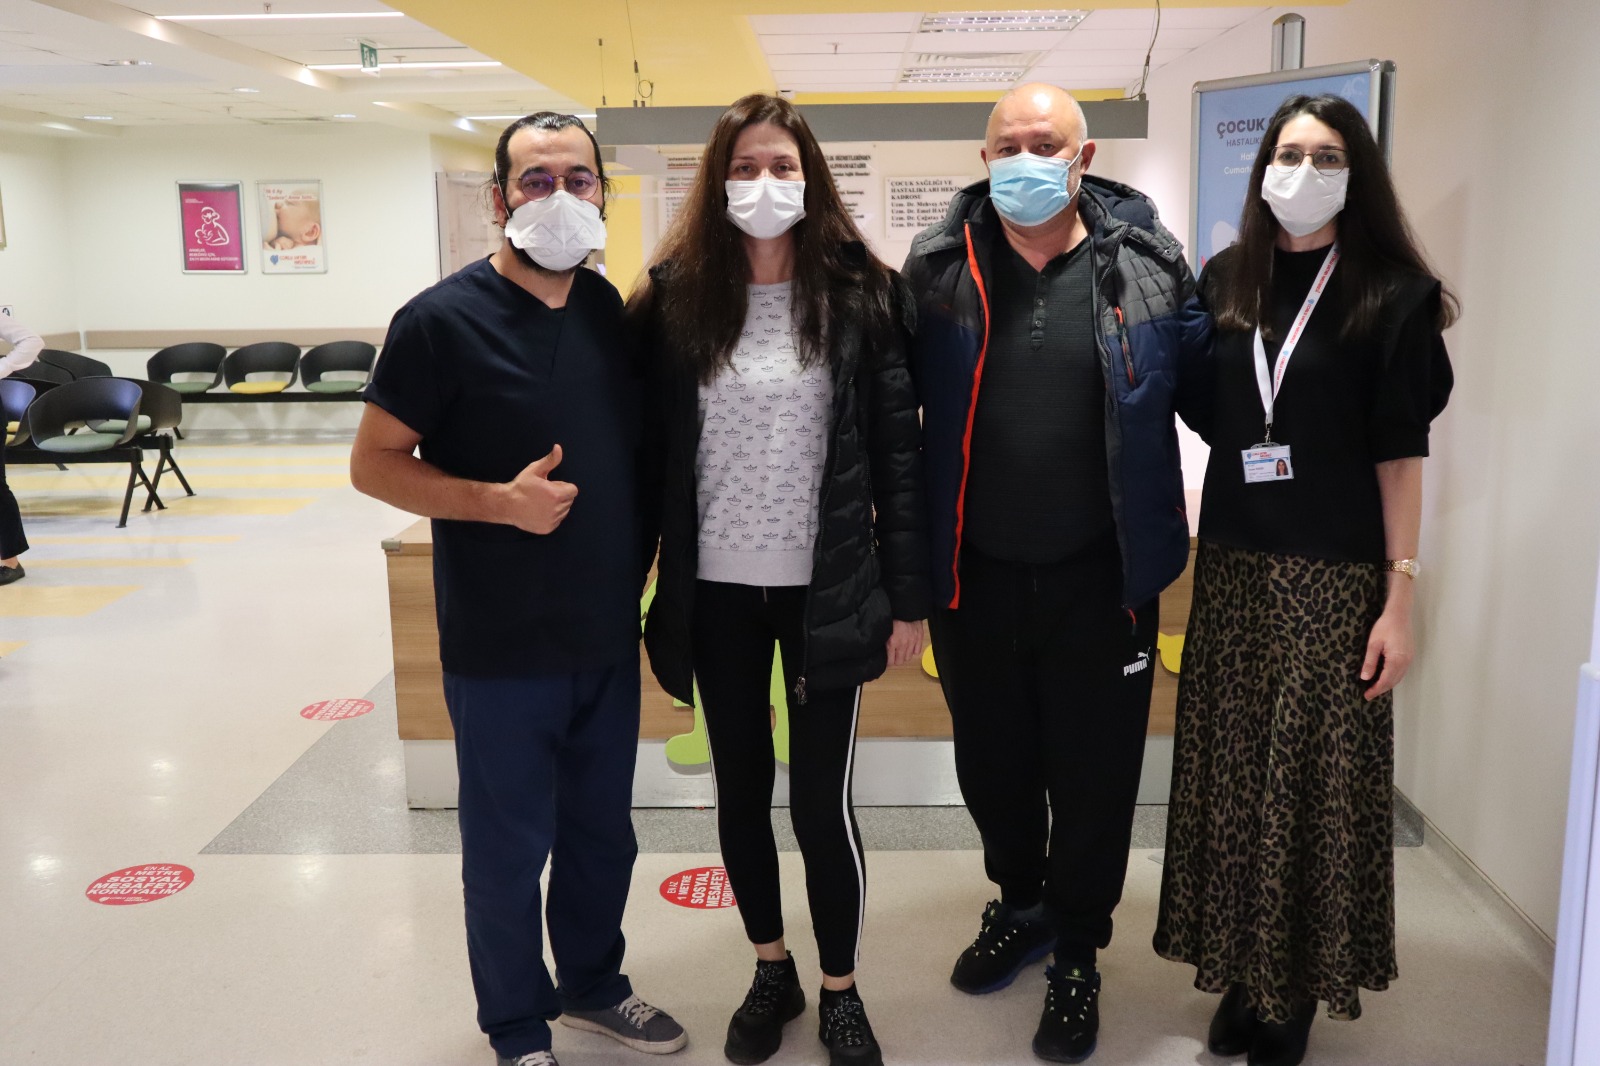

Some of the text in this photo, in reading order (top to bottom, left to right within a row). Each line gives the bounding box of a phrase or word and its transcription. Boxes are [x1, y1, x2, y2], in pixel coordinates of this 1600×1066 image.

[1217, 118, 1265, 139] ÇOCUK
[1124, 658, 1148, 676] PUMA
[678, 875, 692, 895] METRE
[690, 871, 710, 904] SOSYAL
[706, 868, 725, 906] MESAFEYİ
